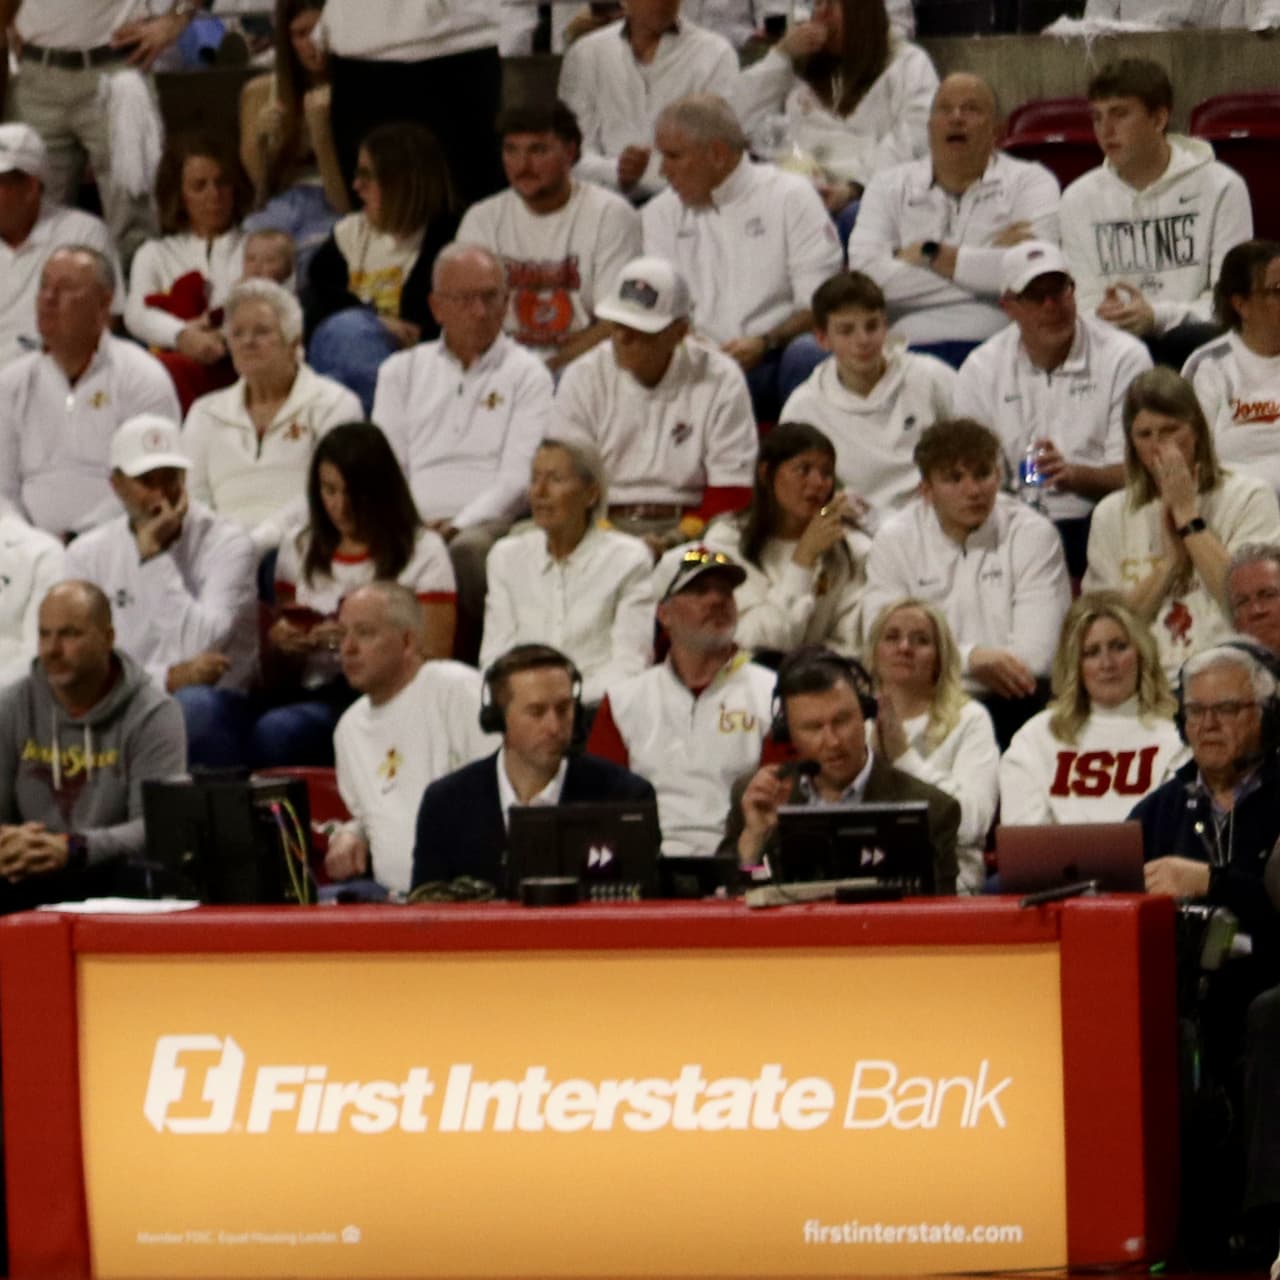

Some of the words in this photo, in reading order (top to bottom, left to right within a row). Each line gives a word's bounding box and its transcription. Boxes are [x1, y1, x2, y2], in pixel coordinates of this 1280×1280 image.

[1095, 214, 1197, 275] CYCLONES
[1048, 745, 1161, 798] ISU
[247, 1064, 434, 1134] First
[438, 1062, 835, 1133] Interstate
[843, 1058, 1014, 1130] Bank
[803, 1219, 1023, 1244] firstinterstate.com
